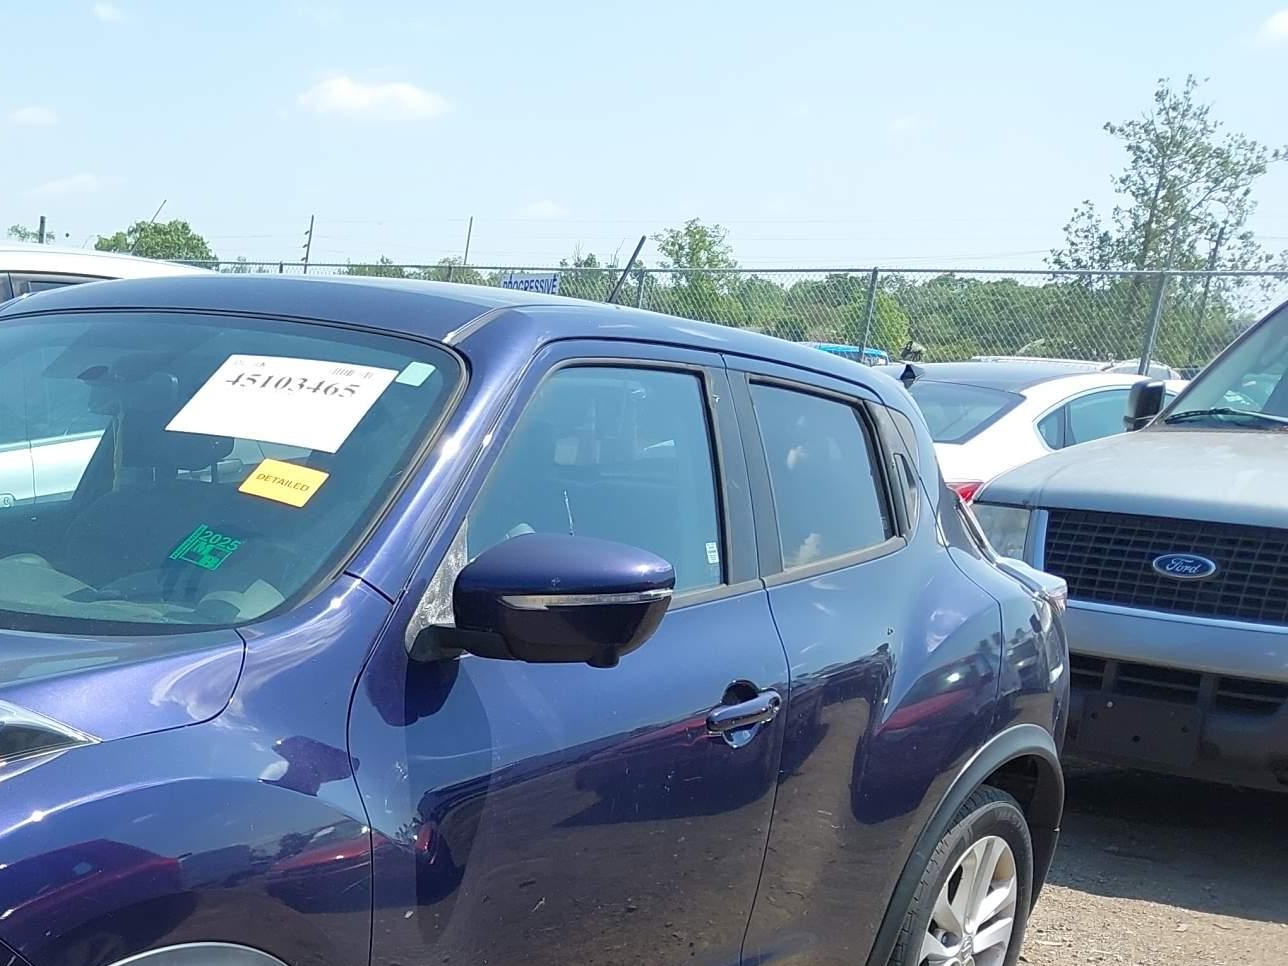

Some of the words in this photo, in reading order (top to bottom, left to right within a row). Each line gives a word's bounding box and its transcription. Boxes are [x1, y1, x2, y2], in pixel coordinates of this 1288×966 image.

[225, 371, 360, 398] 45103465
[255, 473, 311, 492] DETAILED
[198, 530, 242, 552] 2025
[1165, 557, 1201, 574] Ford
